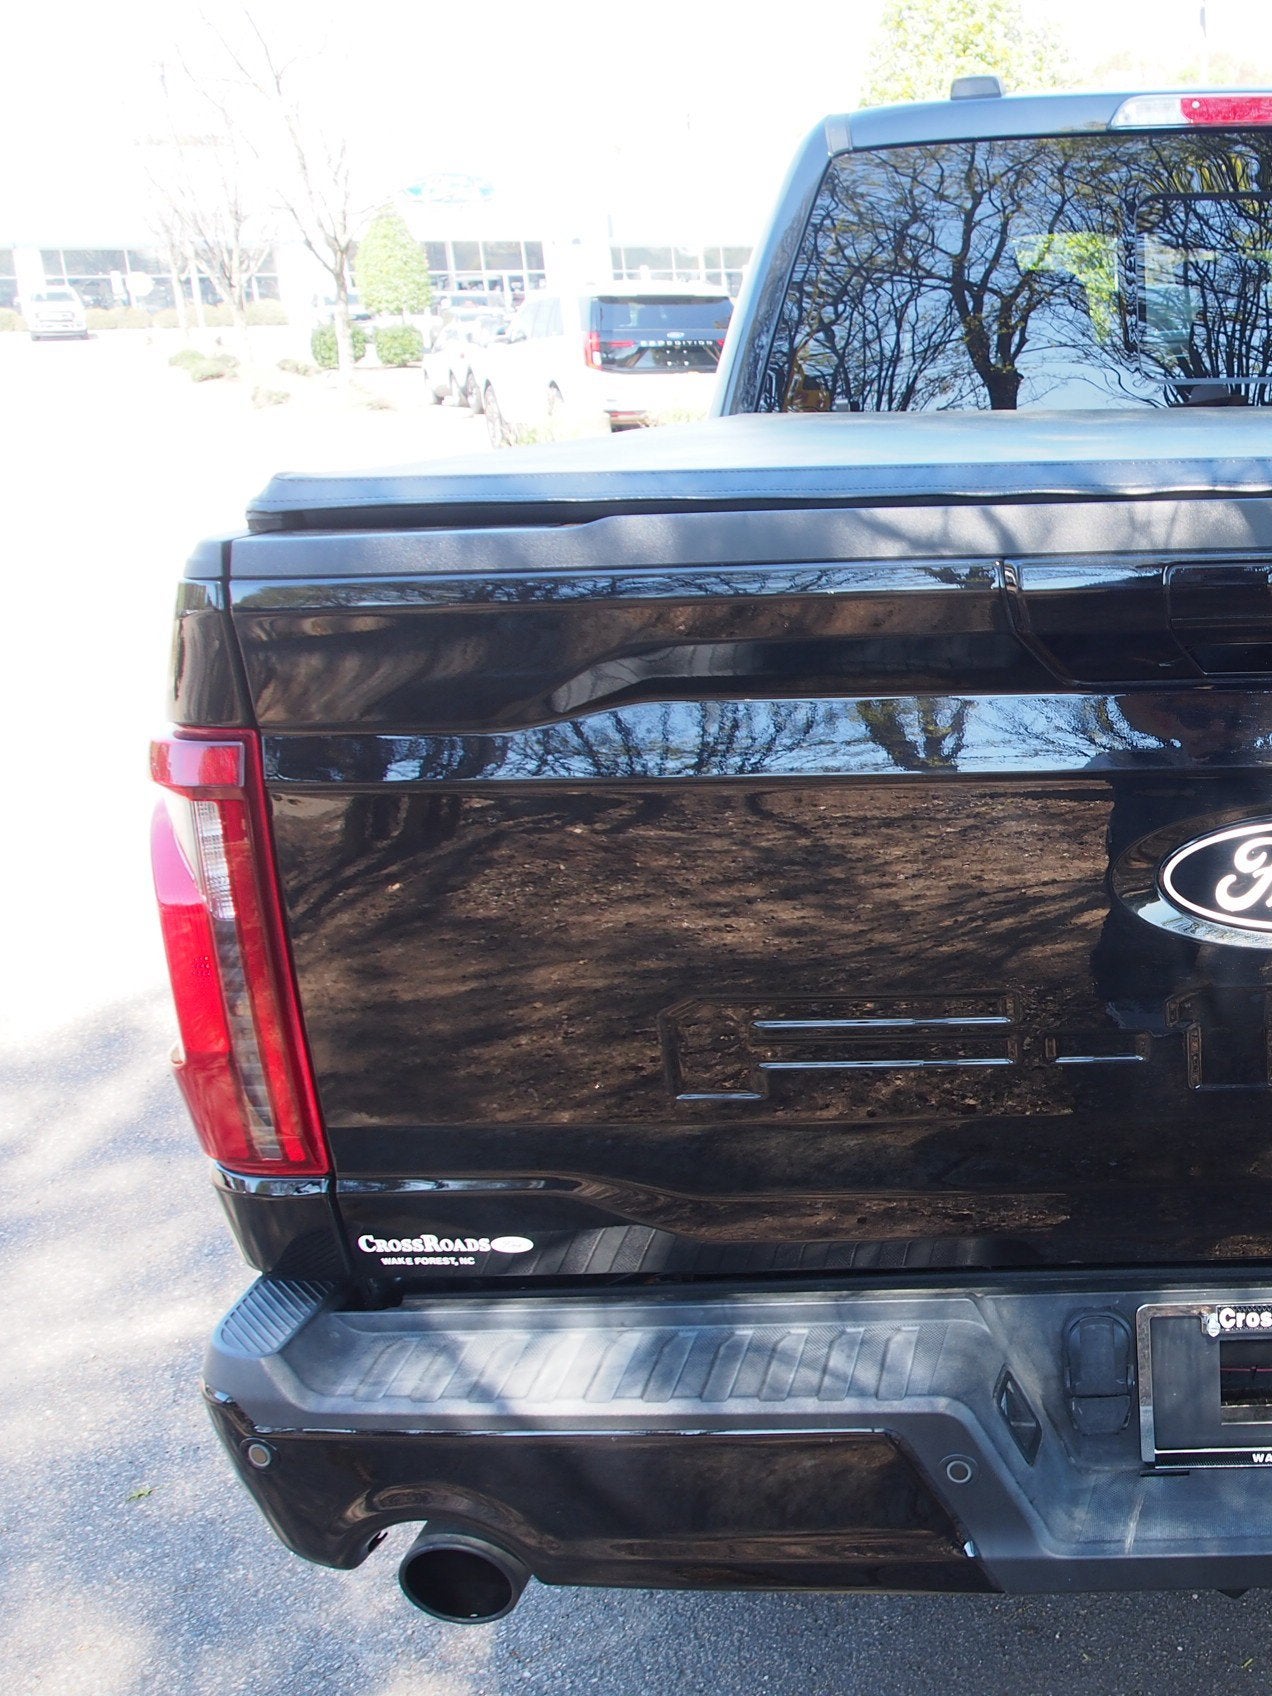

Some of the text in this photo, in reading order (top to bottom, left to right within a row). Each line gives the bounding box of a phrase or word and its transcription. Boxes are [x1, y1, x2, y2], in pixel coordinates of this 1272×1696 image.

[381, 1256, 476, 1266] WAKE FOREST, NC
